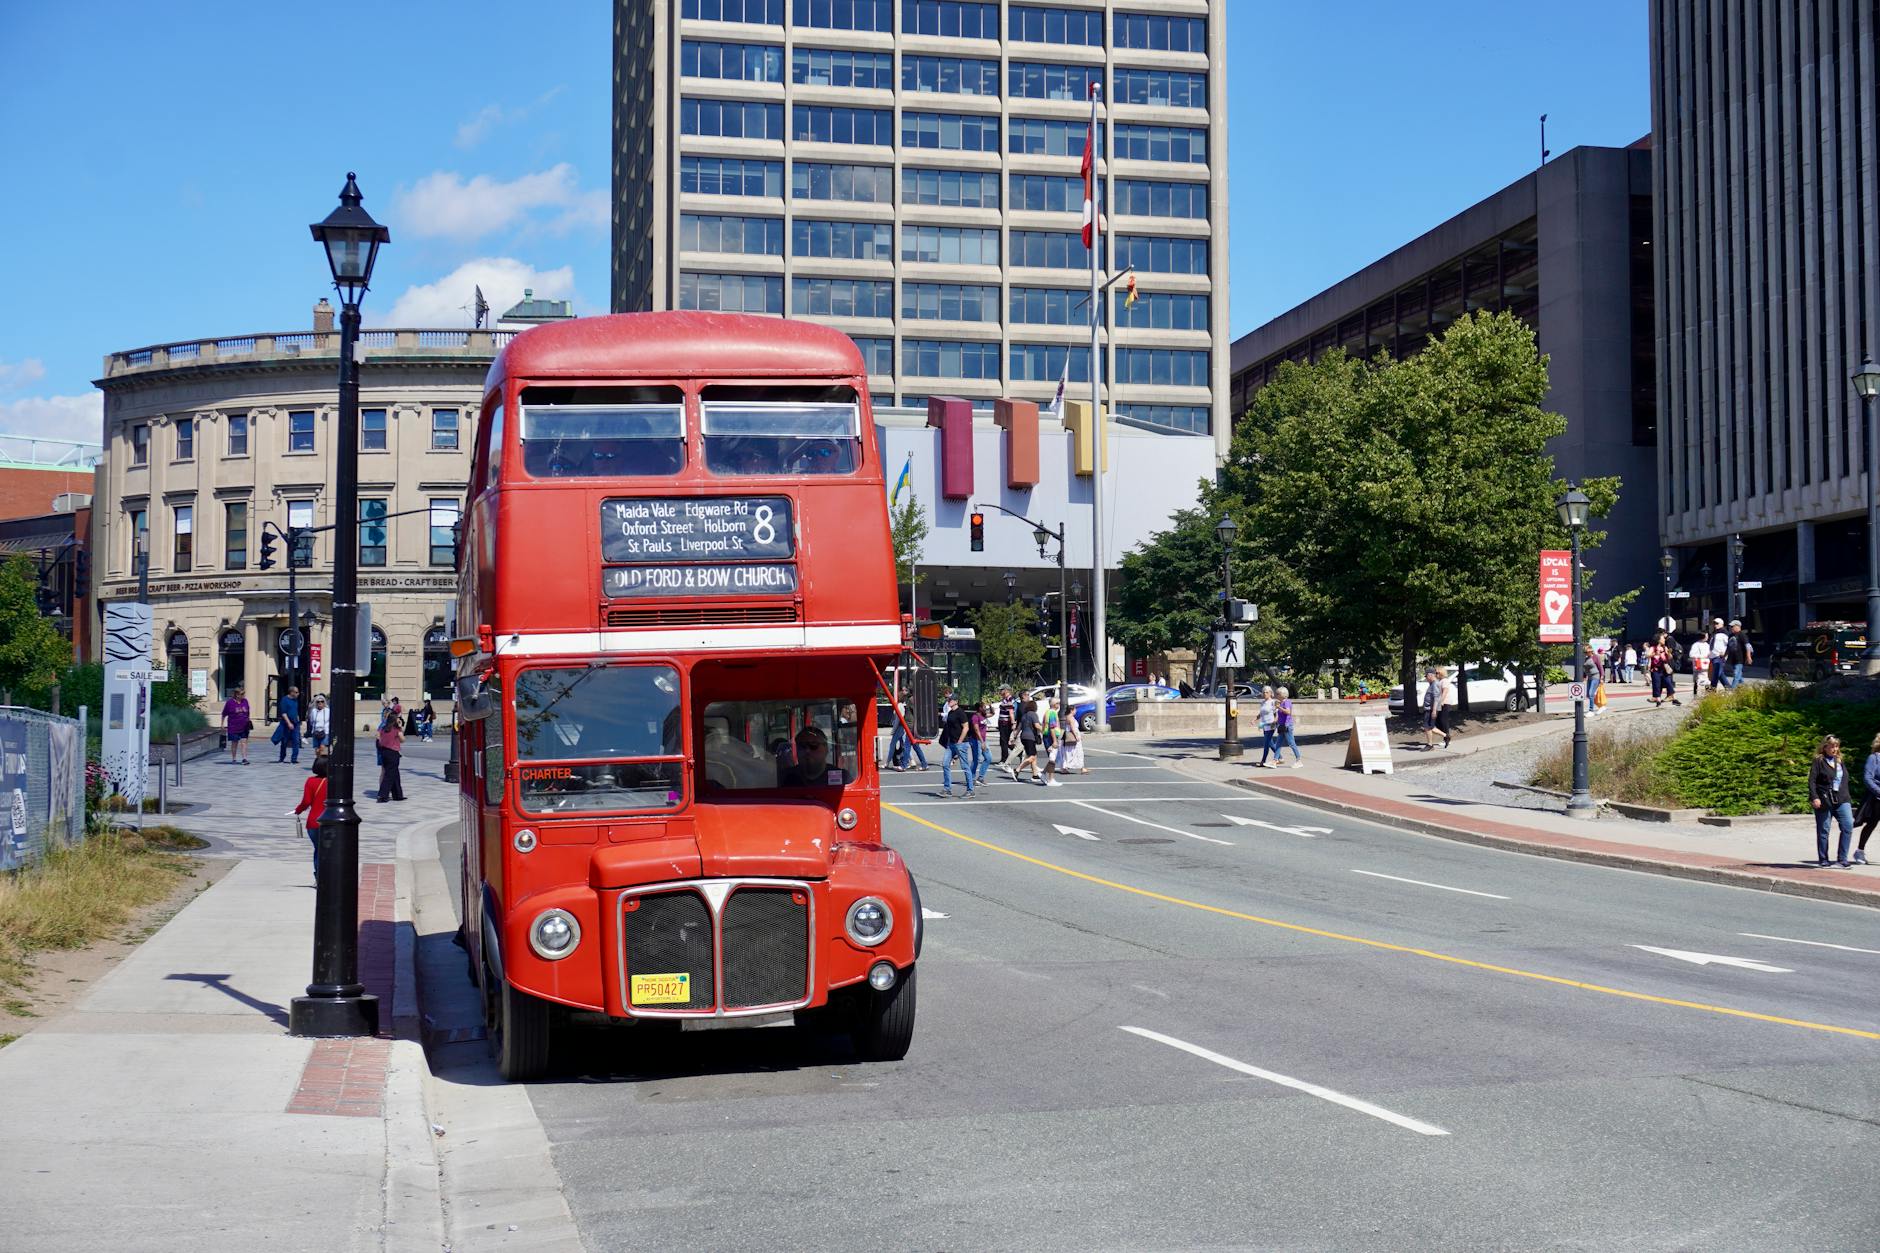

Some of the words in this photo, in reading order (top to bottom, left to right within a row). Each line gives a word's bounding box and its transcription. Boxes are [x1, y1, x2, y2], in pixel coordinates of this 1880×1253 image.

[616, 504, 649, 518] Maida
[651, 503, 676, 517] Vale
[685, 503, 731, 519] Edgware
[734, 501, 748, 515] Rd
[622, 521, 657, 535] Oxford
[661, 520, 694, 534] Street
[704, 519, 746, 533] Holborn
[753, 505, 775, 545] 8
[628, 539, 640, 553] St
[643, 538, 672, 552] Pauls
[681, 536, 729, 555] Liverpool
[732, 536, 743, 550] St
[433, 578, 453, 586] BEER
[615, 569, 641, 588] OLD
[645, 568, 682, 587] FORD
[685, 568, 695, 587] &
[697, 567, 730, 587] BOW
[734, 566, 786, 586] CHURCH
[128, 586, 141, 594] BREA
[148, 584, 165, 593] CRAFT
[166, 583, 181, 592] BEER
[184, 582, 203, 590] PIZZA
[203, 581, 242, 590] WORKSHOP
[521, 767, 571, 780] CHARTER
[637, 982, 684, 996] PR50427
